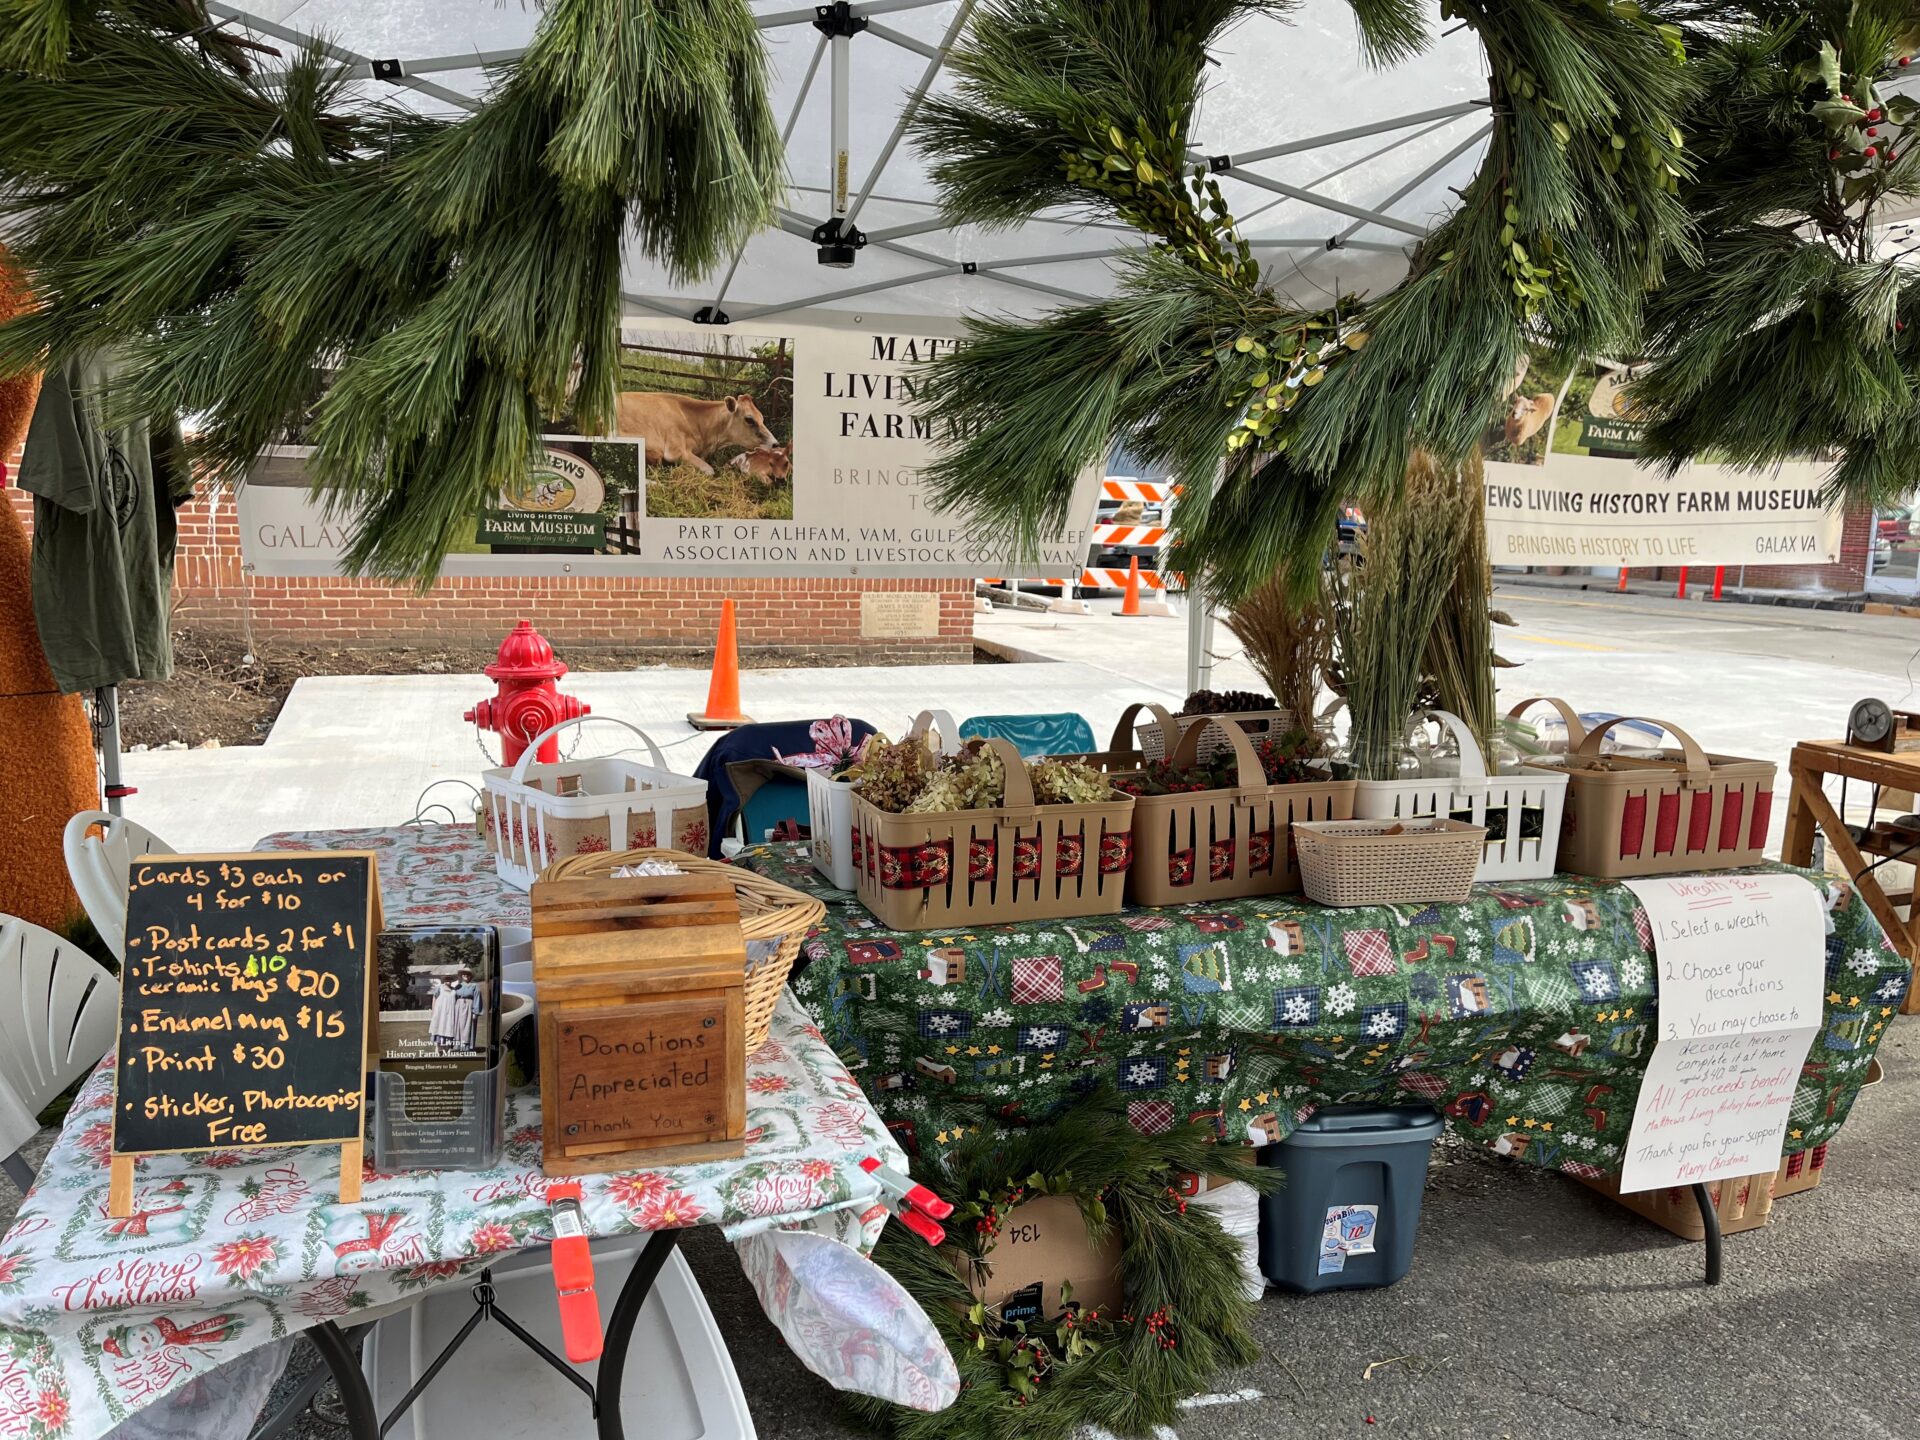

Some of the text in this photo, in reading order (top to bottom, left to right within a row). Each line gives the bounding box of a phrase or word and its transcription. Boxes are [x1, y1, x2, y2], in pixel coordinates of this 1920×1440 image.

[839, 412, 933, 440] FARM
[1587, 424, 1623, 440] FARM
[1528, 488, 1583, 513] LIVING
[1590, 492, 1669, 514] HISTORY
[1677, 491, 1730, 513] FARM
[1737, 489, 1823, 512] MUSEUM
[484, 519, 596, 535] FARM MUSEUM
[678, 525, 722, 540] PART
[734, 526, 760, 540] OF
[770, 527, 851, 542] ALHFAM,
[859, 528, 902, 543] VAM,
[910, 529, 956, 543] GULF
[663, 546, 795, 561] ASSOCIATION
[808, 547, 846, 561] AND
[856, 547, 957, 562] LIVESTOCK
[1507, 534, 1816, 556] BRINGING HISTORY TO LIFE GALAX VA
[137, 862, 346, 888] Cards $3 each or
[1667, 878, 1729, 898] Wreath
[186, 889, 301, 911] 4 for $10
[276, 928, 295, 953] 2
[299, 926, 328, 951] for
[332, 921, 355, 950] $1
[1671, 916, 1709, 940] Select
[1714, 922, 1725, 932] a
[1727, 911, 1770, 931] wreath
[141, 953, 288, 978] T-shirts $10
[1682, 961, 1732, 981] Choose
[1738, 959, 1765, 987] your
[286, 965, 340, 999] $20
[1705, 978, 1784, 1002] decorations
[141, 1006, 233, 1035] Enamel
[296, 1005, 345, 1039] $15
[1690, 1013, 1716, 1035] You
[1721, 1017, 1748, 1034] may
[1750, 1010, 1788, 1028] choose
[1790, 1007, 1799, 1020] to
[386, 1050, 417, 1059] History
[418, 1050, 440, 1058] Farm
[578, 1030, 705, 1057] Donations
[1679, 1037, 1742, 1056] decorate
[1778, 1034, 1793, 1044] or
[141, 1042, 285, 1073] Print $30
[568, 1058, 710, 1101] Appreciated
[1646, 1067, 1793, 1113] All proceeds benefit
[206, 1116, 268, 1143] Free
[577, 1113, 684, 1132] Thank You
[1636, 1143, 1674, 1163] Thank
[1679, 1142, 1700, 1162] you
[1701, 1133, 1718, 1152] for
[1720, 1136, 1745, 1155] your
[756, 1175, 814, 1203] Merry
[1010, 1223, 1041, 1245] 134
[97, 1253, 203, 1295] Merry
[52, 1277, 201, 1312] Christmas
[1005, 1305, 1037, 1321] prime
